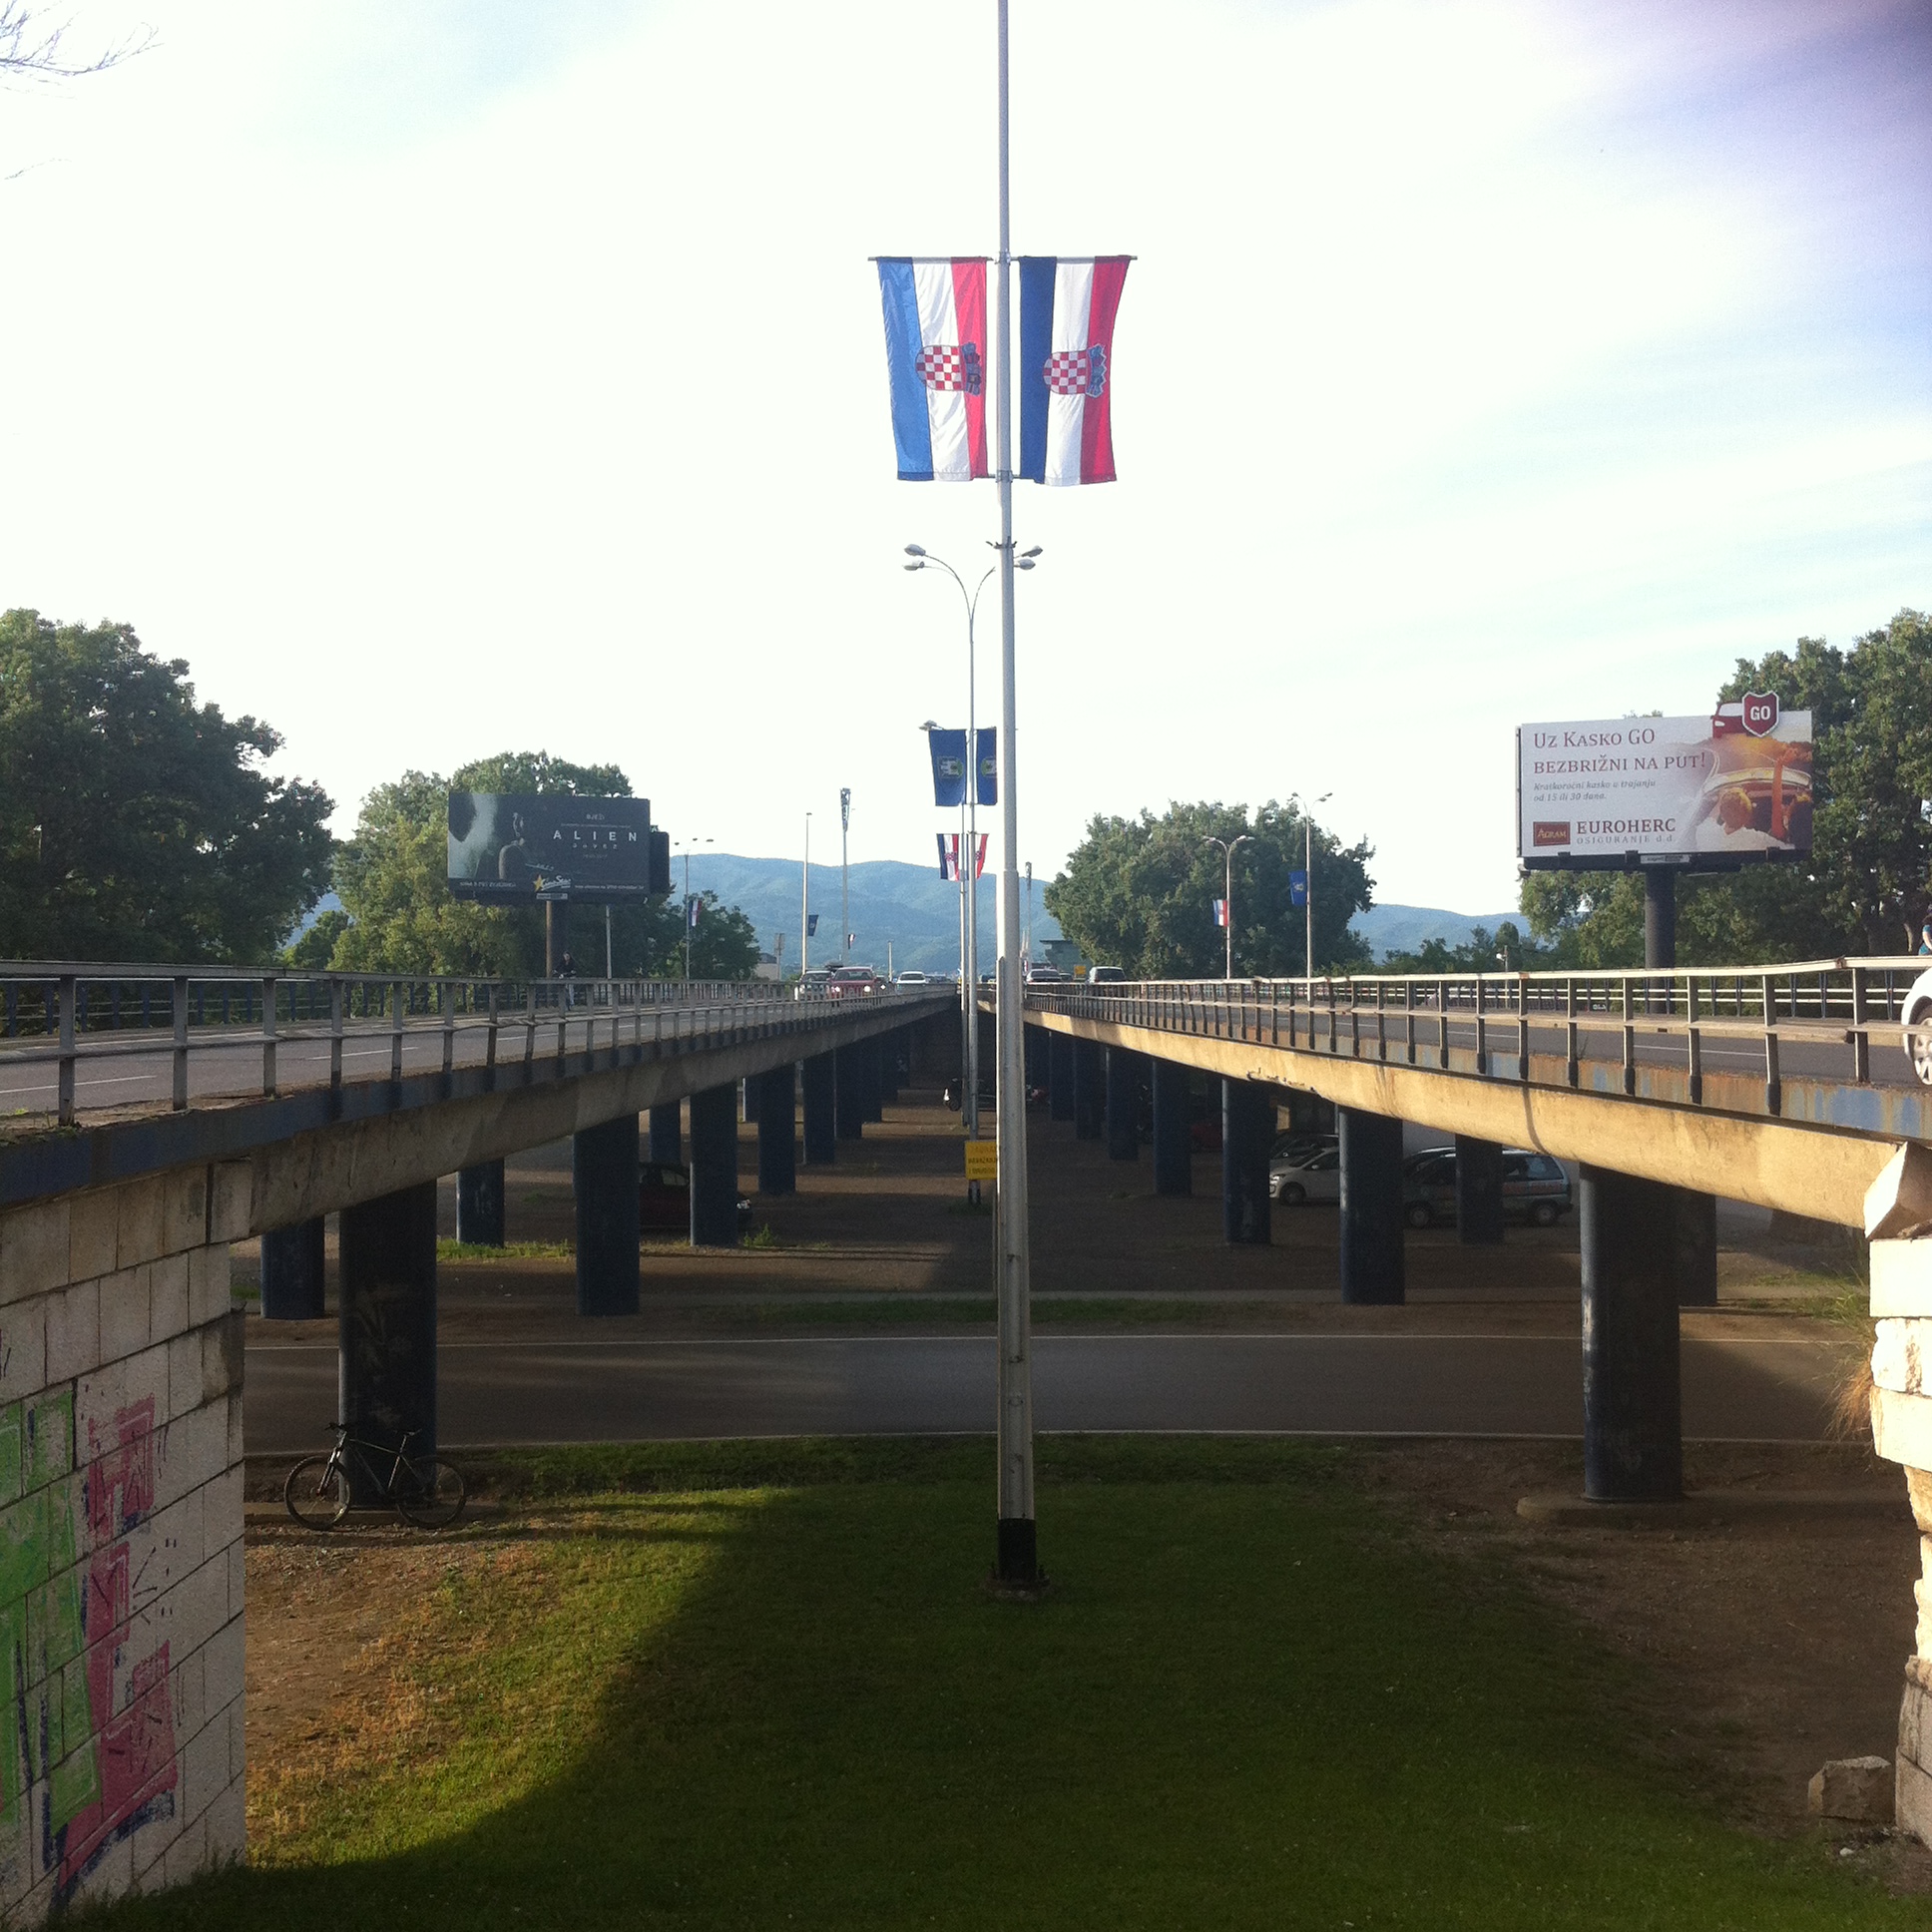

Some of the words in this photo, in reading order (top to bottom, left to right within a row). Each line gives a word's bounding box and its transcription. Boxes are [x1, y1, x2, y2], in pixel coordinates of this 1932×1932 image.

[1750, 706, 1770, 721] GO
[1628, 728, 1656, 744] GO
[1534, 753, 1628, 773] BEZBRIŽNI
[1634, 756, 1659, 769] NA
[1665, 751, 1705, 769] PUT!
[1586, 779, 1611, 789] kasko
[1620, 778, 1656, 789] trajanju
[1534, 793, 1544, 802] od
[1559, 792, 1568, 801] ili
[1570, 792, 1581, 801] 30
[1583, 791, 1607, 800] dana.
[1577, 818, 1676, 834] EUROHERC
[553, 830, 637, 842] ALIEN
[1577, 835, 1650, 844] OSIGURANJE
